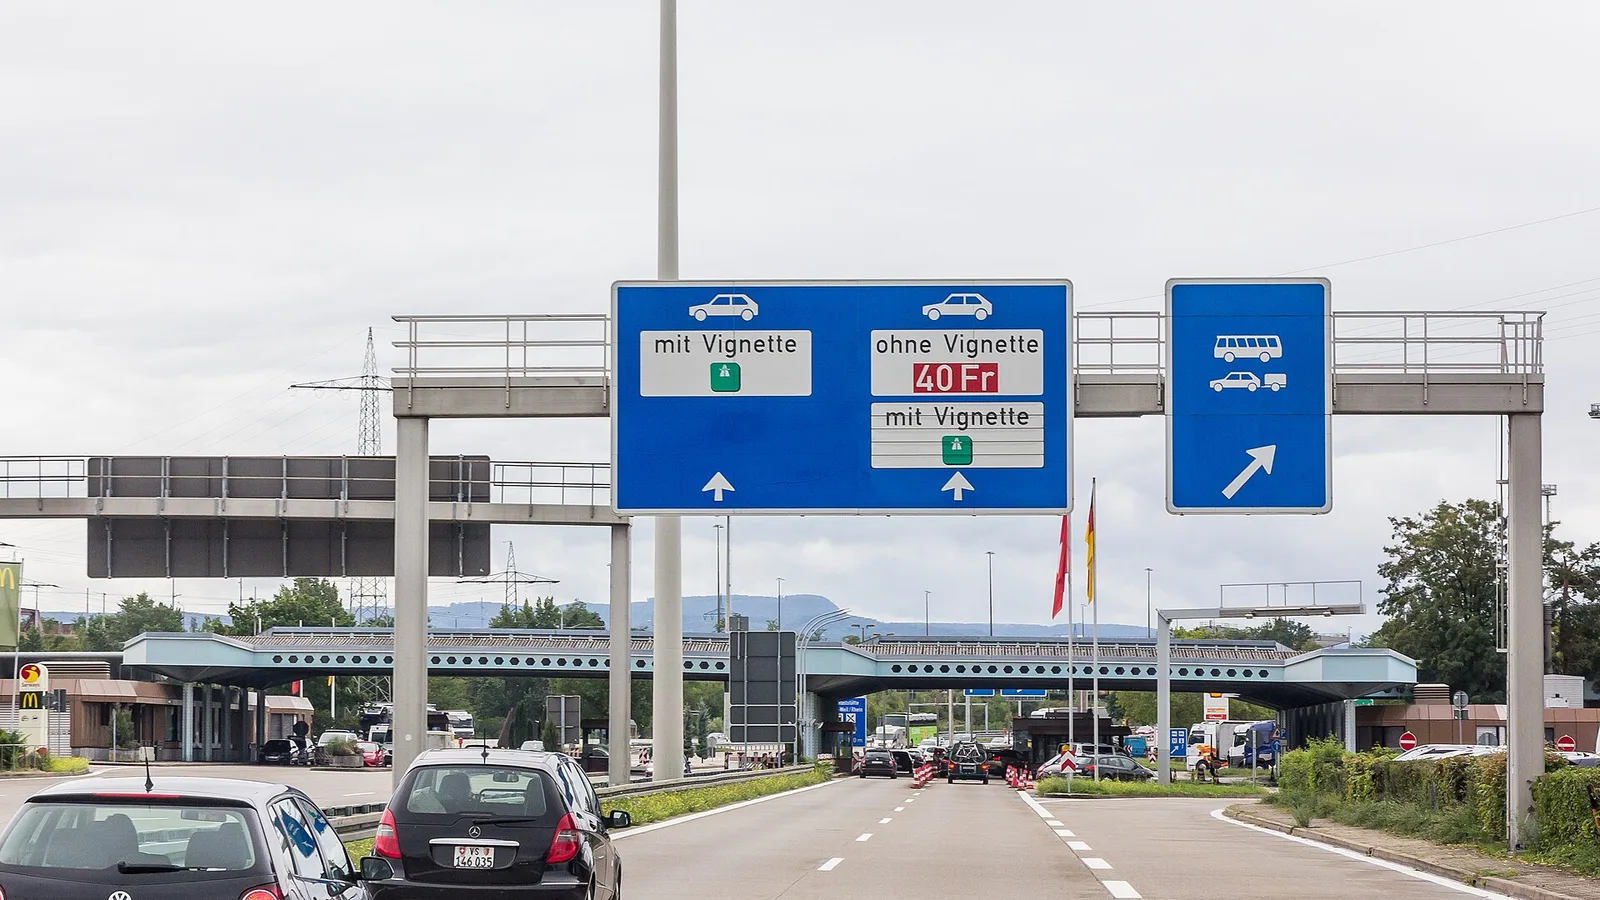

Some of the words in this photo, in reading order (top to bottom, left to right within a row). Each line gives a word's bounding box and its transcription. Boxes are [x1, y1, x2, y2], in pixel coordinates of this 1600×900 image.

[655, 335, 691, 354] mit
[702, 334, 797, 358] Vignette
[876, 335, 932, 354] ohne
[943, 334, 1039, 359] Vignette
[915, 364, 953, 392] 40
[961, 364, 996, 392] Fr
[886, 406, 923, 426] mit
[934, 406, 1029, 430] Vignette
[455, 856, 473, 867] 146
[474, 857, 493, 868] 035
[469, 847, 480, 855] VS
